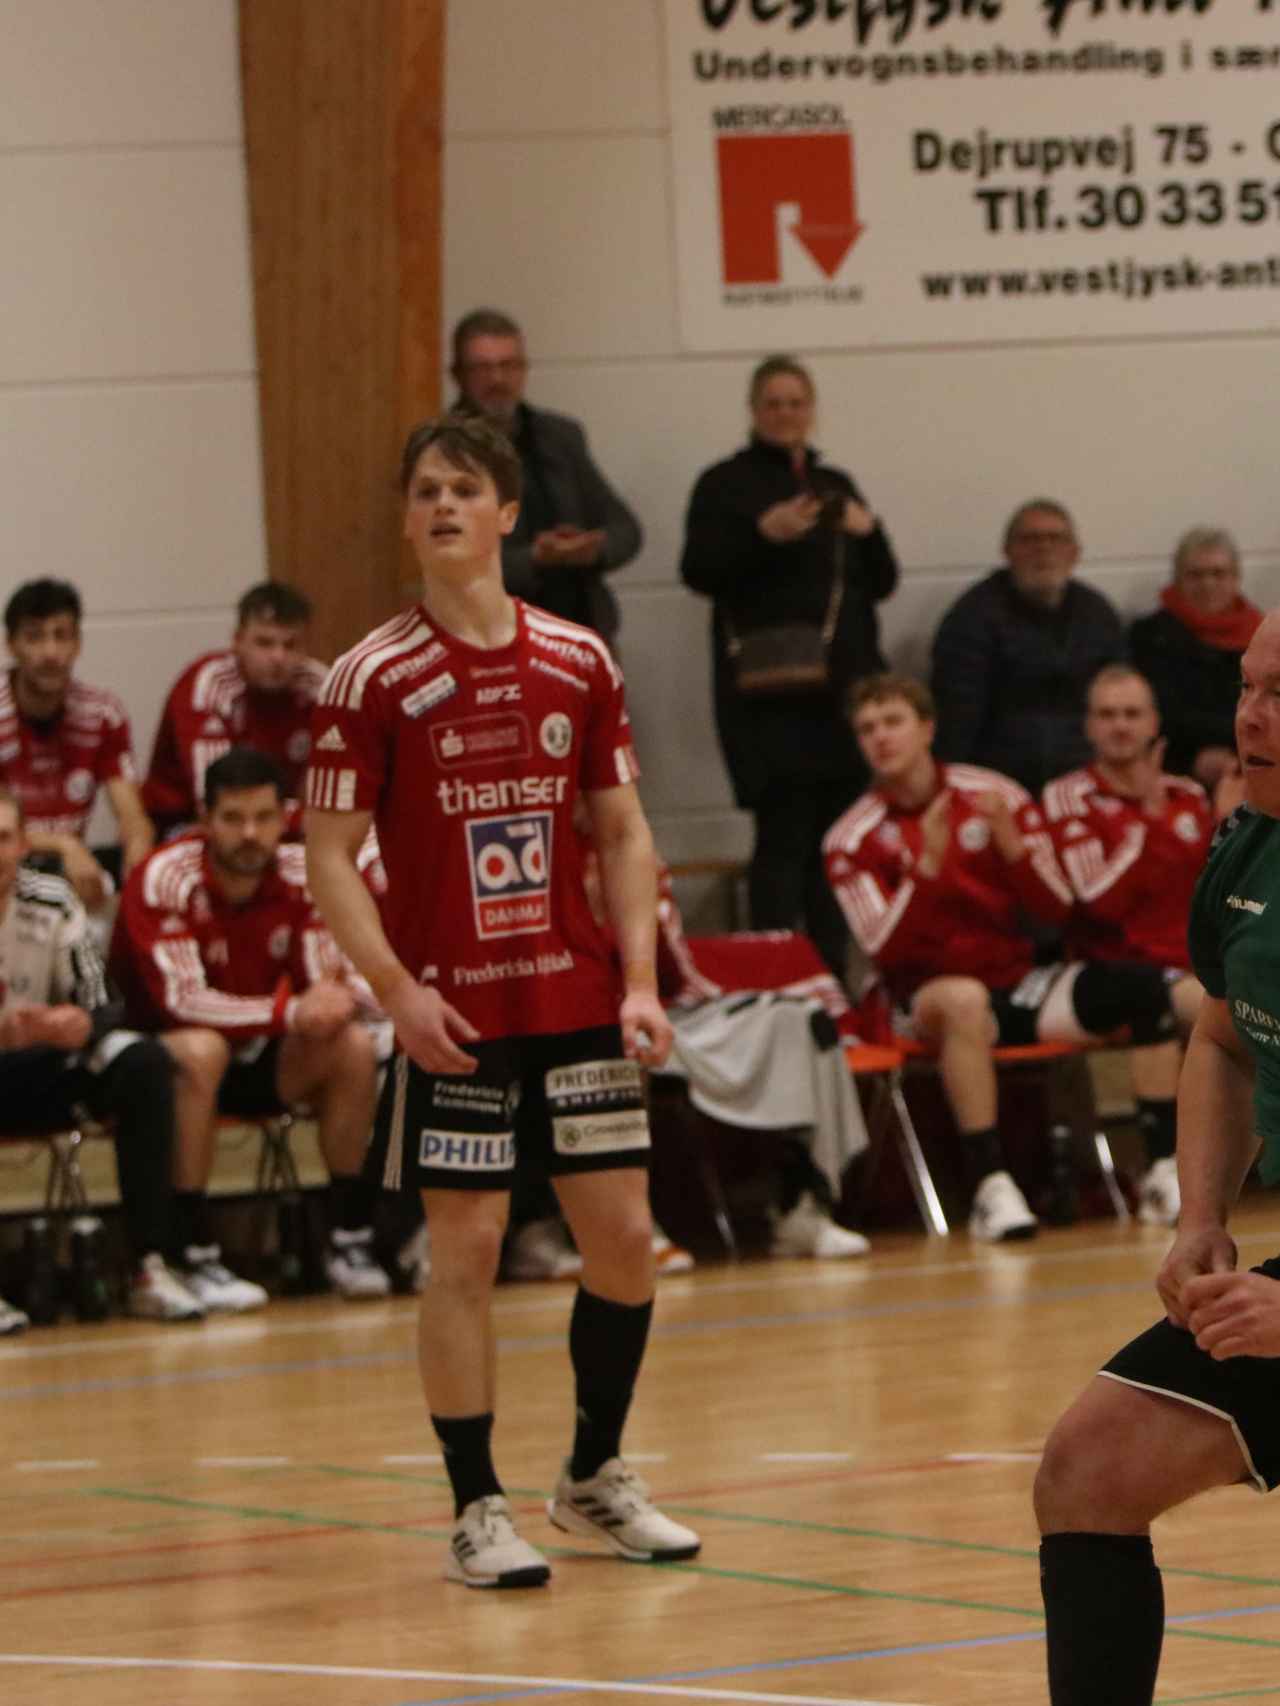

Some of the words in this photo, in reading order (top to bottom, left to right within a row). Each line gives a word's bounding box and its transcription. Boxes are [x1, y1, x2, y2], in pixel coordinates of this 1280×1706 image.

[692, 42, 1164, 84] Undervognsbehandling
[1181, 40, 1194, 70] i
[914, 126, 1135, 179] Dejrupvej
[1156, 124, 1209, 164] 75
[975, 187, 1068, 232] Tlf.
